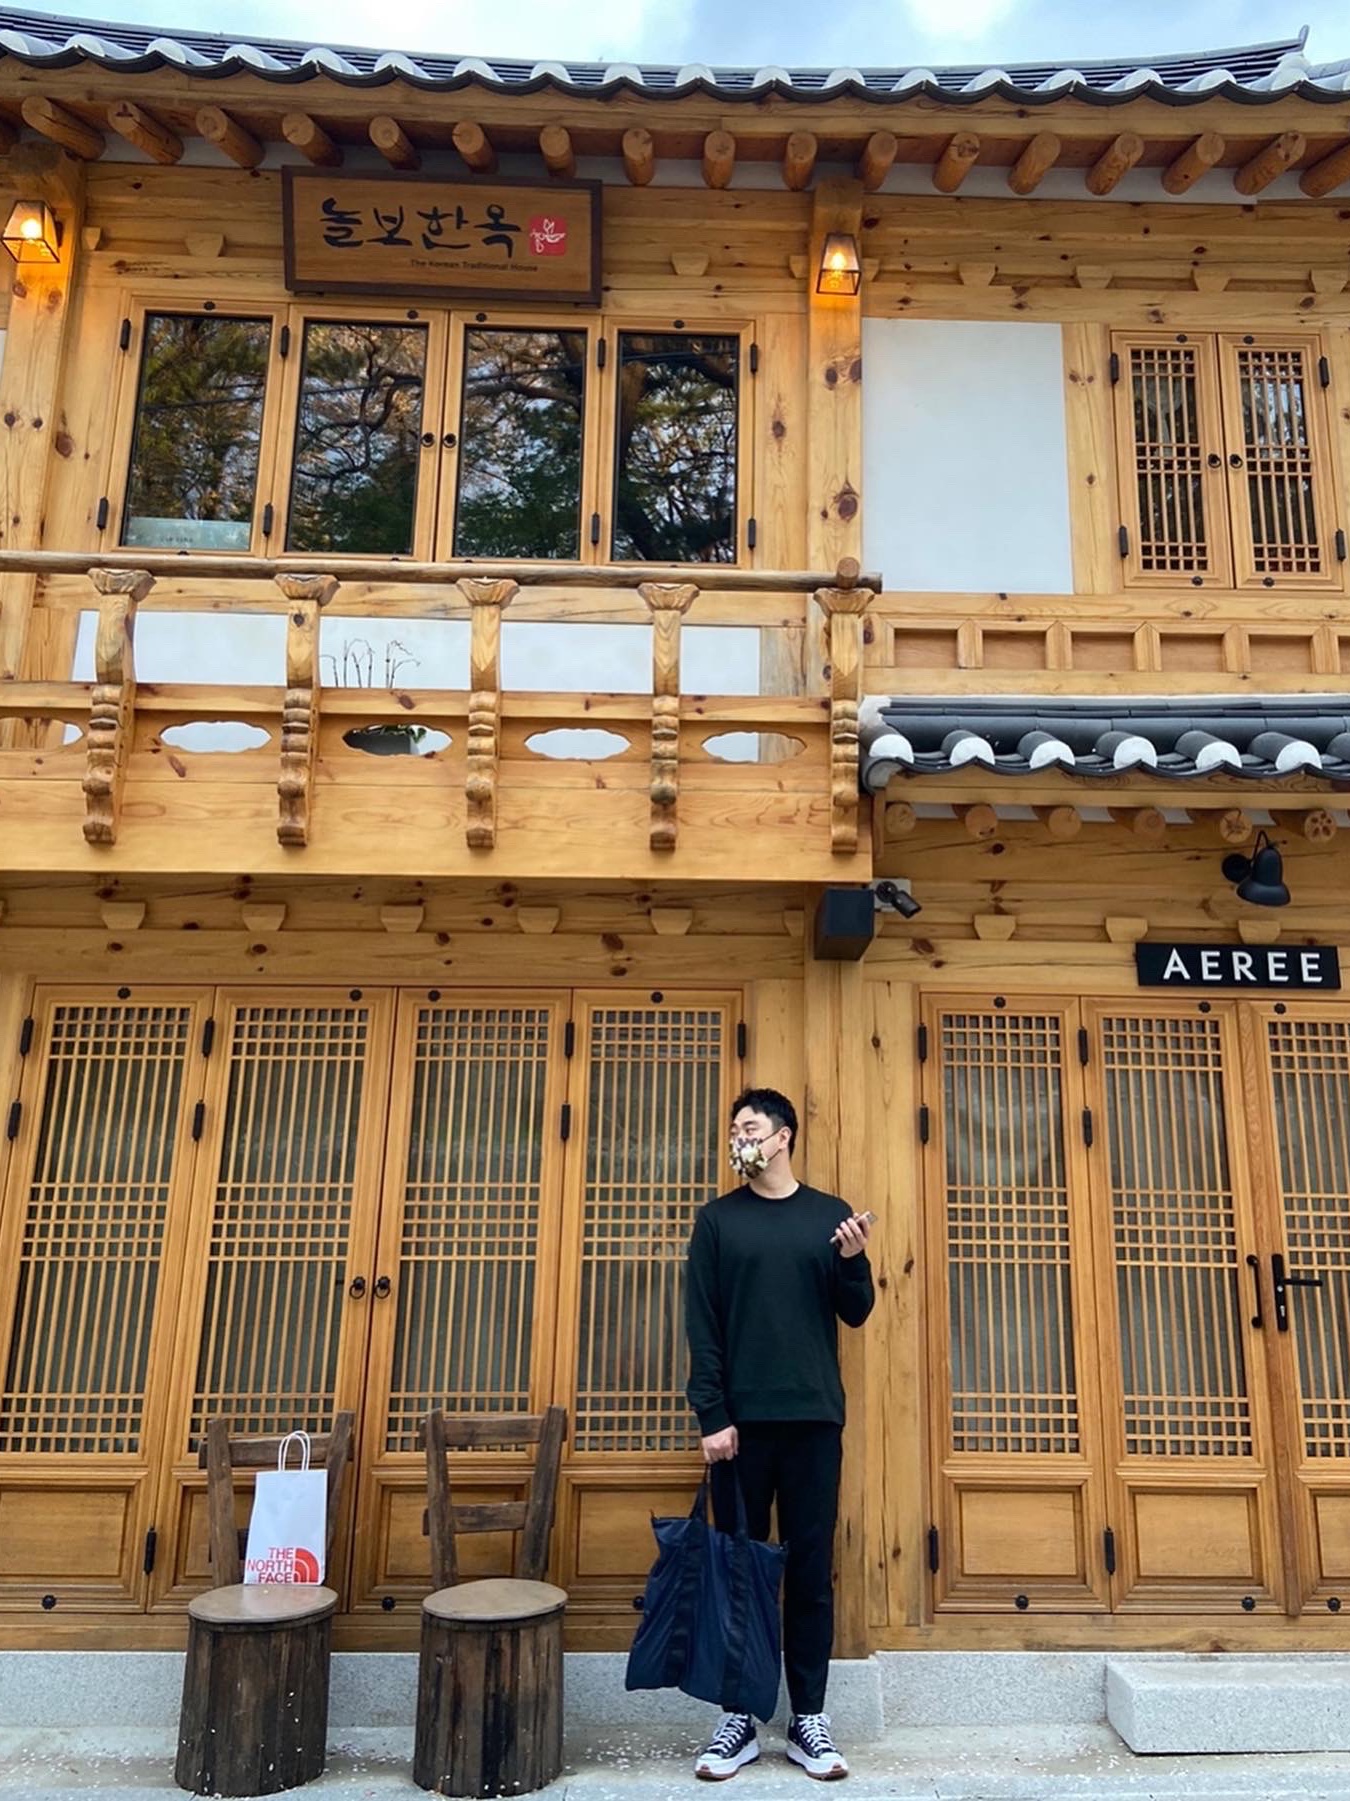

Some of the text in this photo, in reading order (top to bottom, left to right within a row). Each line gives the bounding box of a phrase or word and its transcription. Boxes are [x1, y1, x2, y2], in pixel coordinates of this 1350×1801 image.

[320, 197, 521, 259] 놀보한옥
[411, 259, 539, 272] The Korean Traditional House
[1163, 947, 1323, 983] AEREE
[268, 1547, 293, 1559] THE
[247, 1559, 293, 1572] NORTH
[258, 1572, 292, 1583] FACE
